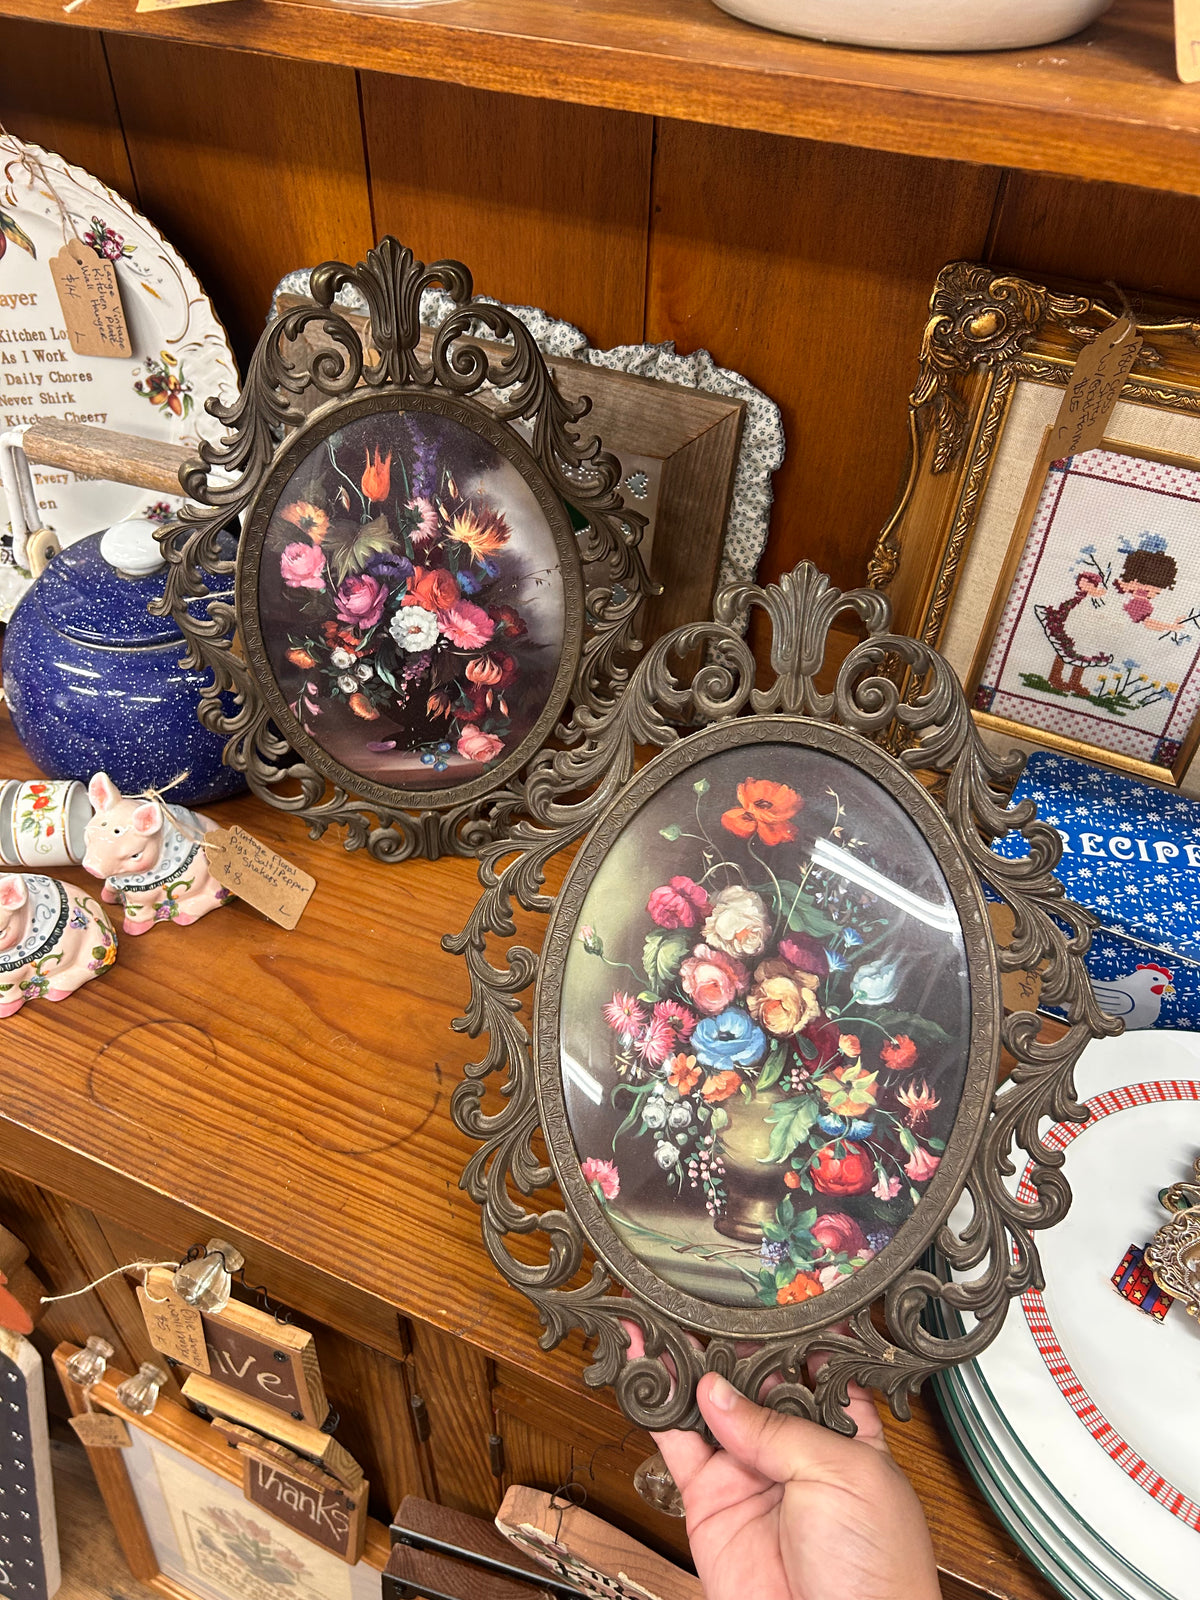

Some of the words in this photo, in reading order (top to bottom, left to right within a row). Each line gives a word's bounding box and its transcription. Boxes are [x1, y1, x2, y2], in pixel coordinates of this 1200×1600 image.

[61, 274, 81, 299] $14
[81, 265, 94, 289] Wall
[92, 268, 107, 310] Kitchen
[103, 264, 115, 297] Large
[112, 305, 126, 350] Vintage
[50, 327, 69, 341] Lo
[1, 351, 17, 364] As
[22, 350, 29, 363] I
[32, 349, 69, 362] Work
[1113, 341, 1139, 377] 1984
[4, 372, 43, 386] Daily
[49, 371, 93, 383] Chores
[39, 391, 76, 404] Shirk
[34, 473, 69, 485] Every
[229, 836, 247, 855] Pigs
[235, 826, 267, 856] Vintage
